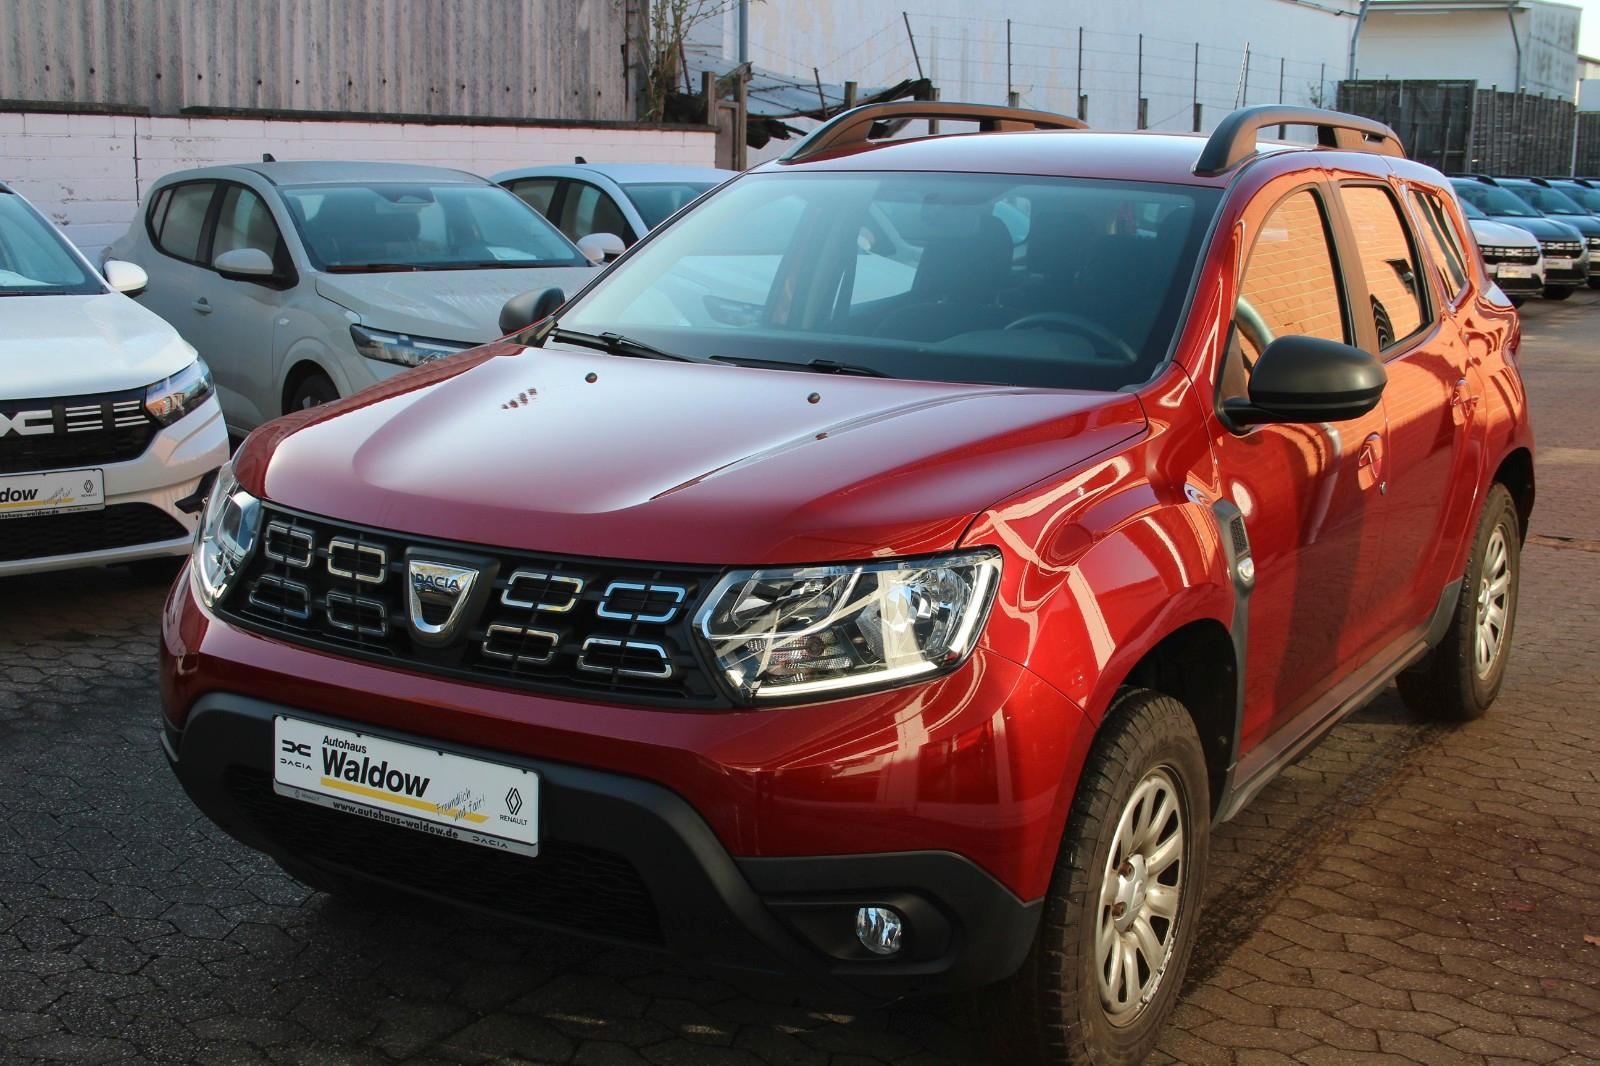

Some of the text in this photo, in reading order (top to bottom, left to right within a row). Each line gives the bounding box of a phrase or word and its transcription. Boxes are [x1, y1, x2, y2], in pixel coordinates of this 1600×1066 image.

[415, 572, 461, 590] DACIA
[322, 735, 367, 753] Autohaus
[280, 758, 313, 770] DACIA
[322, 747, 430, 797] Waldow
[332, 801, 459, 839] www.autohaus-waldow.de
[499, 813, 528, 826] RENAULT
[472, 835, 508, 849] DACIA
